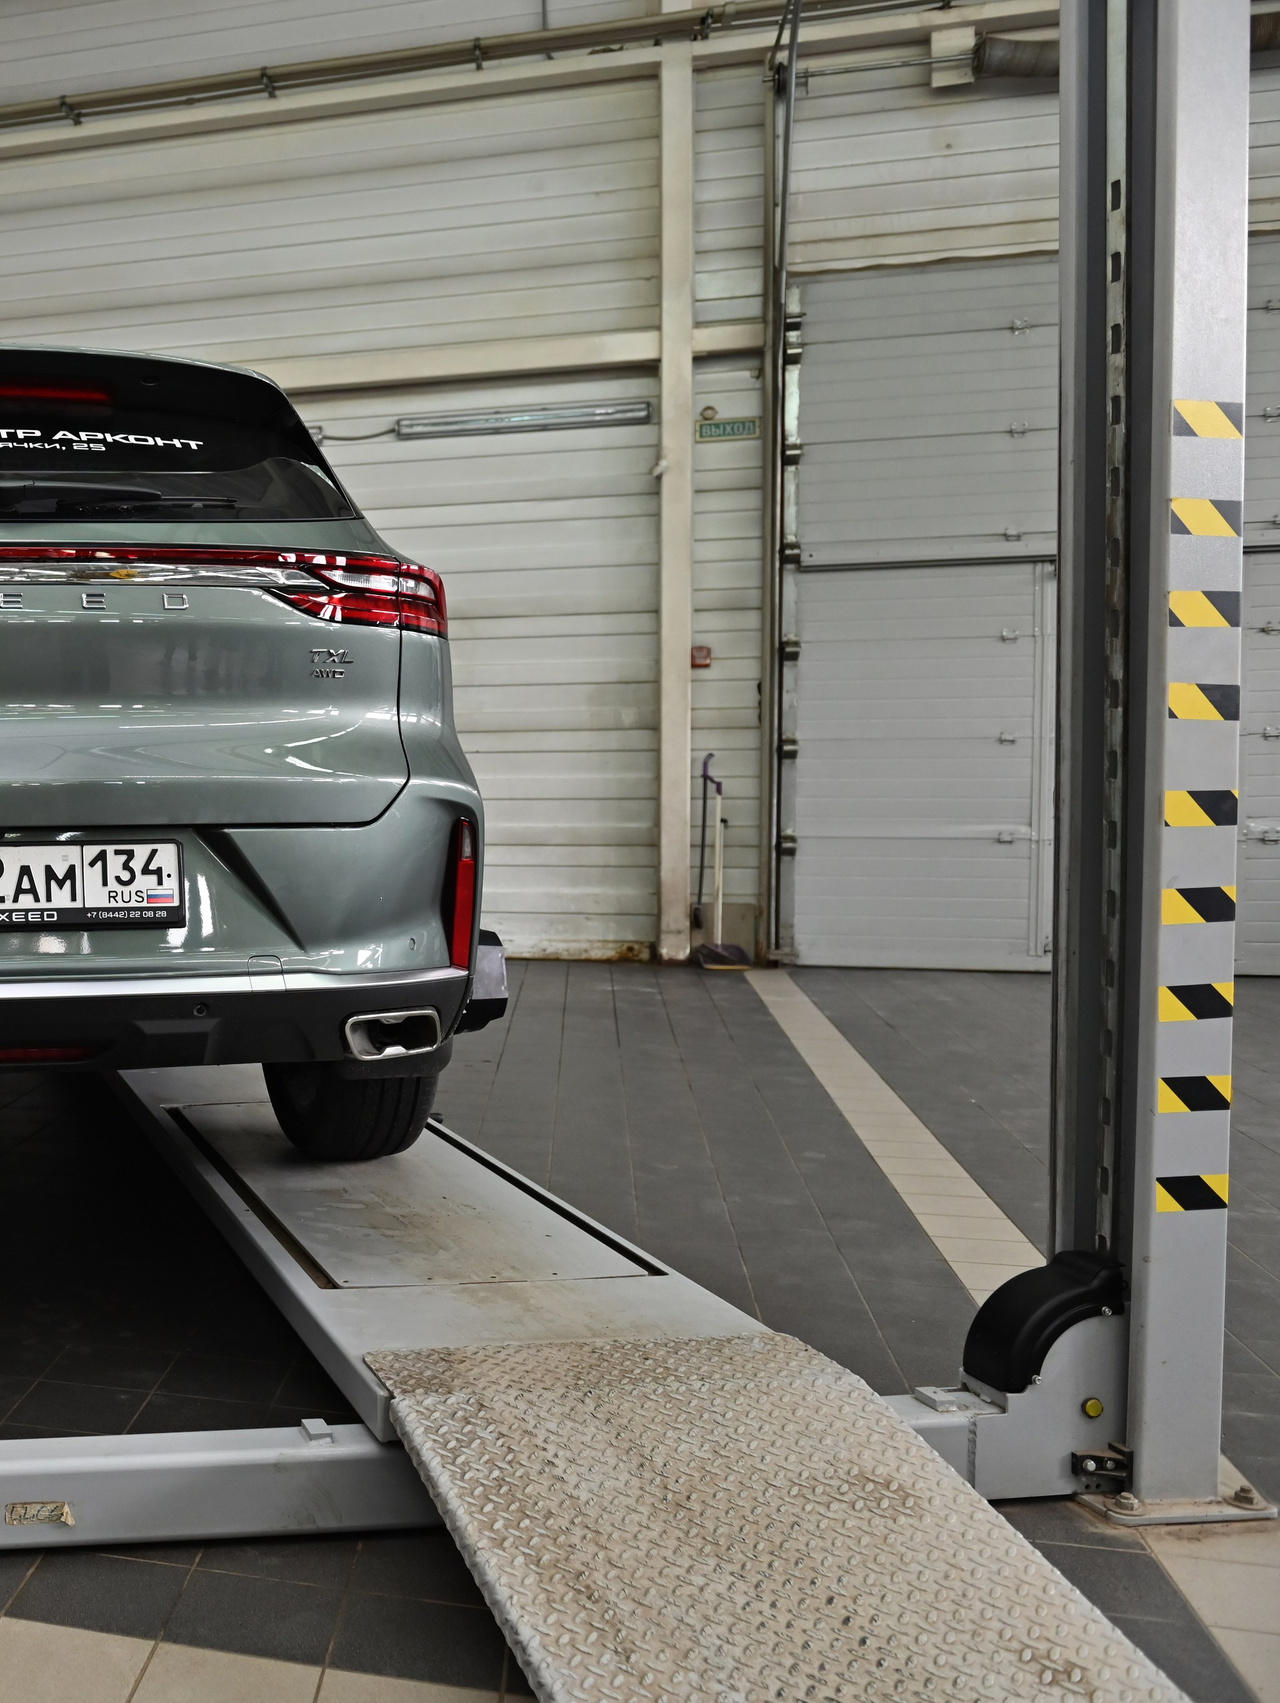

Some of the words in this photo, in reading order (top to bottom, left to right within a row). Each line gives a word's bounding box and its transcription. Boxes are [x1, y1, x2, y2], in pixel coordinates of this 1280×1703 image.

[701, 421, 755, 437] ВЫХОД
[52, 430, 204, 450] АРКОНТ
[72, 442, 106, 451] 25
[311, 648, 354, 664] TXL
[310, 668, 346, 678] AWD
[88, 848, 165, 888] 134
[107, 889, 146, 904] RUS
[129, 910, 141, 918] 22
[155, 910, 167, 918] 28
